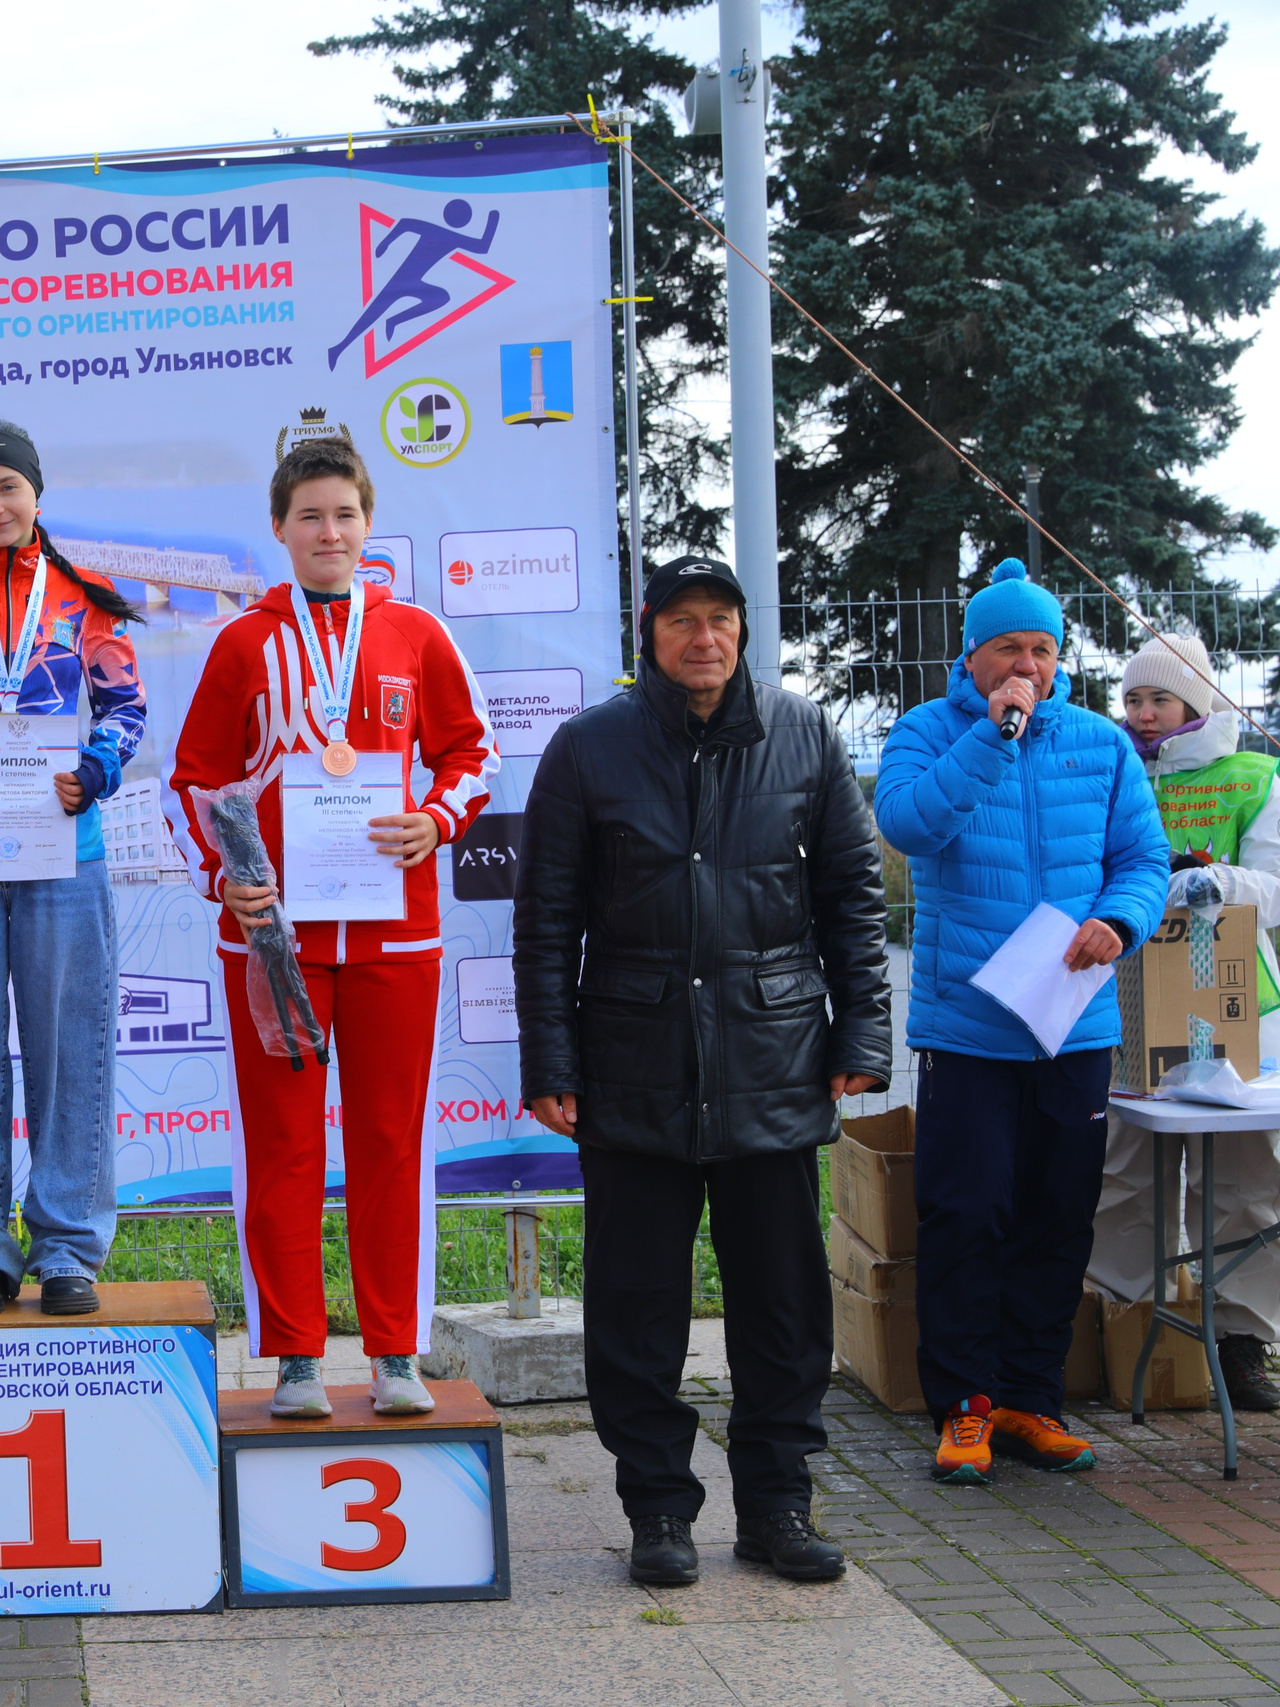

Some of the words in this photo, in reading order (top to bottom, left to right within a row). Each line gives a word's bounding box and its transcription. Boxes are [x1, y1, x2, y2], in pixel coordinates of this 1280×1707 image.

[54, 203, 289, 258] РОССИИ
[38, 300, 295, 337] ОРИЕНТИРОВАНИЯ
[40, 356, 129, 385] город
[135, 346, 293, 374] Ульяновск
[292, 426, 336, 437] ТРИУМФ
[400, 442, 453, 455] УЛСПОРТ
[480, 553, 571, 577] azimut
[481, 582, 510, 591] ОТЕЛЬ
[301, 614, 311, 635] РОССИИ
[349, 612, 359, 653] МИНИСТЕРСТВО
[16, 628, 32, 672] МИНИСТЕРСТВО
[28, 609, 36, 629] СПОРТА
[308, 636, 318, 657] СПОРТА
[344, 654, 352, 675] СПОРТА
[314, 657, 330, 700] МИНИСТЕРСТВО
[341, 676, 349, 700] РОССИИ
[378, 674, 412, 687] МОСКОМСПОРТ
[488, 696, 550, 706] МЕТАЛЛО
[488, 704, 580, 718] ПРОФИЛЬНЫЙ
[490, 720, 532, 730] ЗАВОД
[314, 796, 371, 807] ДИПЛОМ
[36, 1338, 176, 1358] СПОРТИВНОГО
[74, 1380, 164, 1398] ОБЛАСТИ
[320, 1457, 407, 1572] 3
